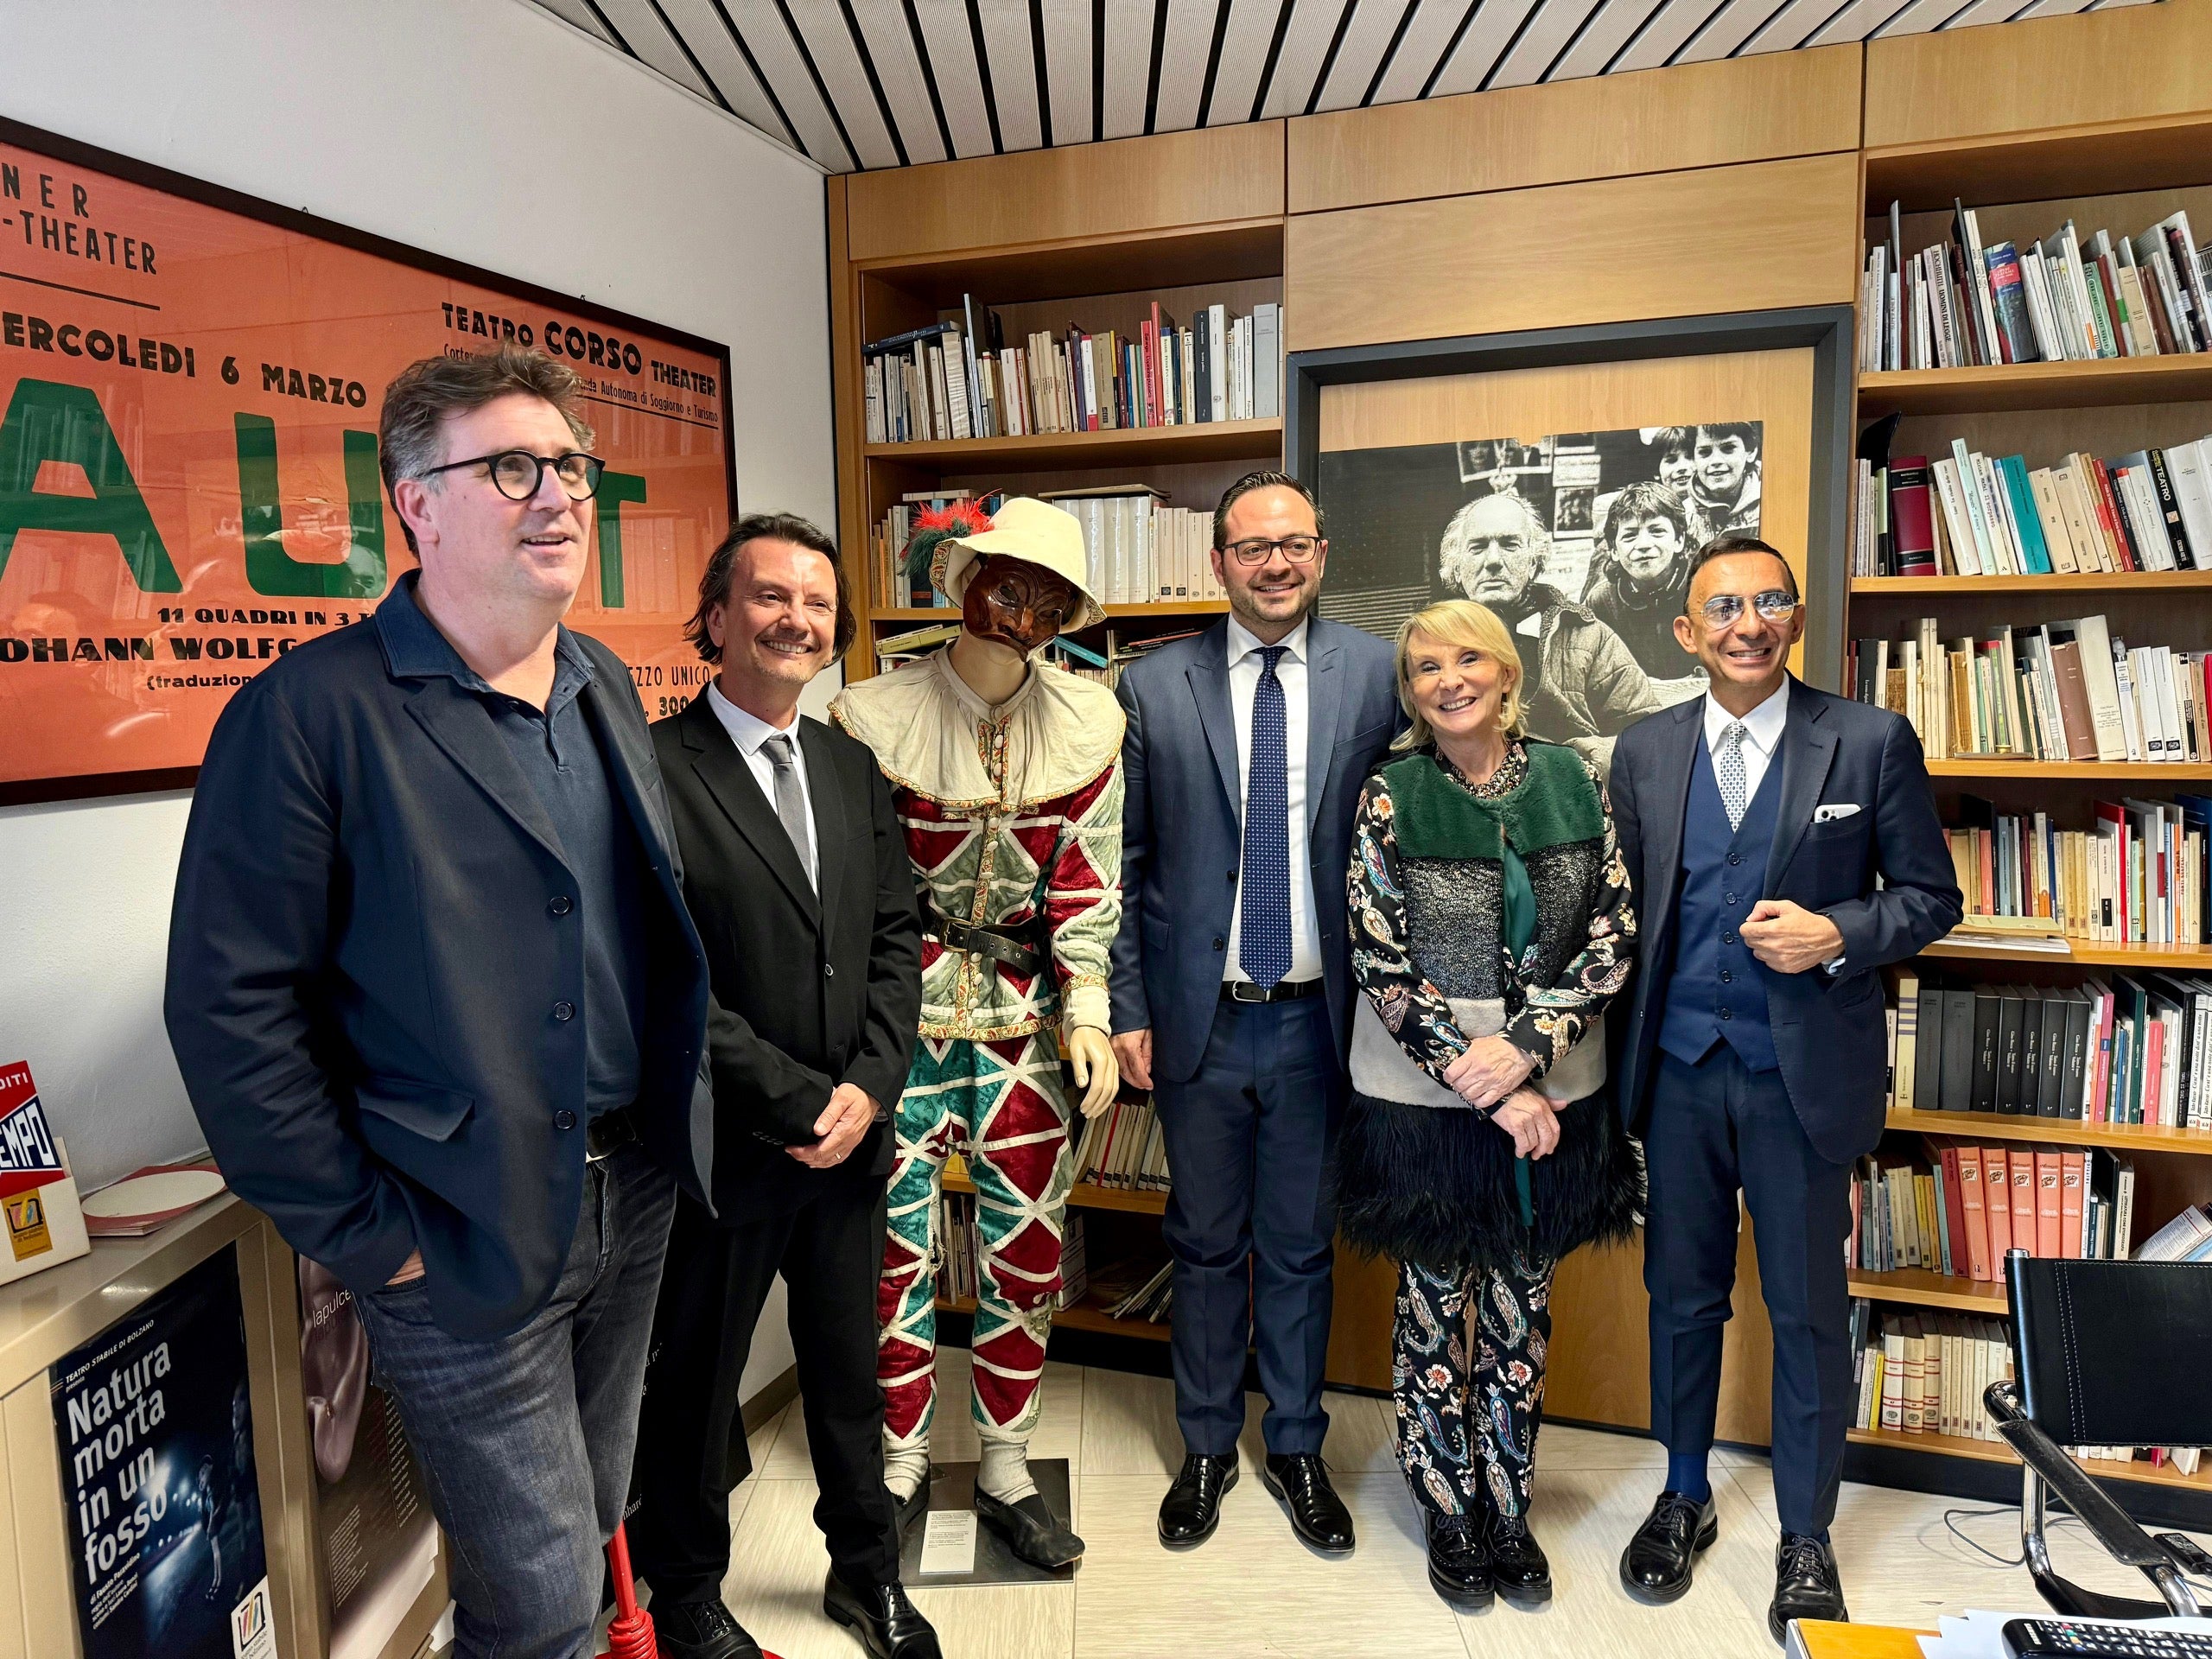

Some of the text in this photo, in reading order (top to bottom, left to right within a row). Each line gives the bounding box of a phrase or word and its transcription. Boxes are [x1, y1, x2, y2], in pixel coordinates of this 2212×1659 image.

[1938, 289, 1948, 314] UOMINI
[442, 302, 716, 397] TEATRO CORSO THEATER
[221, 356, 239, 385] 6
[262, 363, 366, 408] MARZO
[601, 380, 637, 403] Autonoma
[641, 392, 647, 405] di
[651, 394, 684, 415] Soggiorno
[687, 406, 691, 416] e
[695, 403, 719, 423] Turismo
[2156, 465, 2171, 501] TEATRO
[1986, 501, 1996, 528] sorpasso
[157, 607, 185, 624] 11
[195, 608, 297, 625] QUADRI
[305, 612, 327, 626] IN
[334, 613, 350, 626] 3
[671, 665, 710, 687] UNICO
[66, 1319, 154, 1383] TEATRO STABILE DI BOLZANO
[67, 1341, 171, 1445] Natura
[73, 1389, 166, 1488] morta
[78, 1446, 156, 1538] in un
[85, 1486, 167, 1585] fosso
[96, 1578, 114, 1599] Fausto
